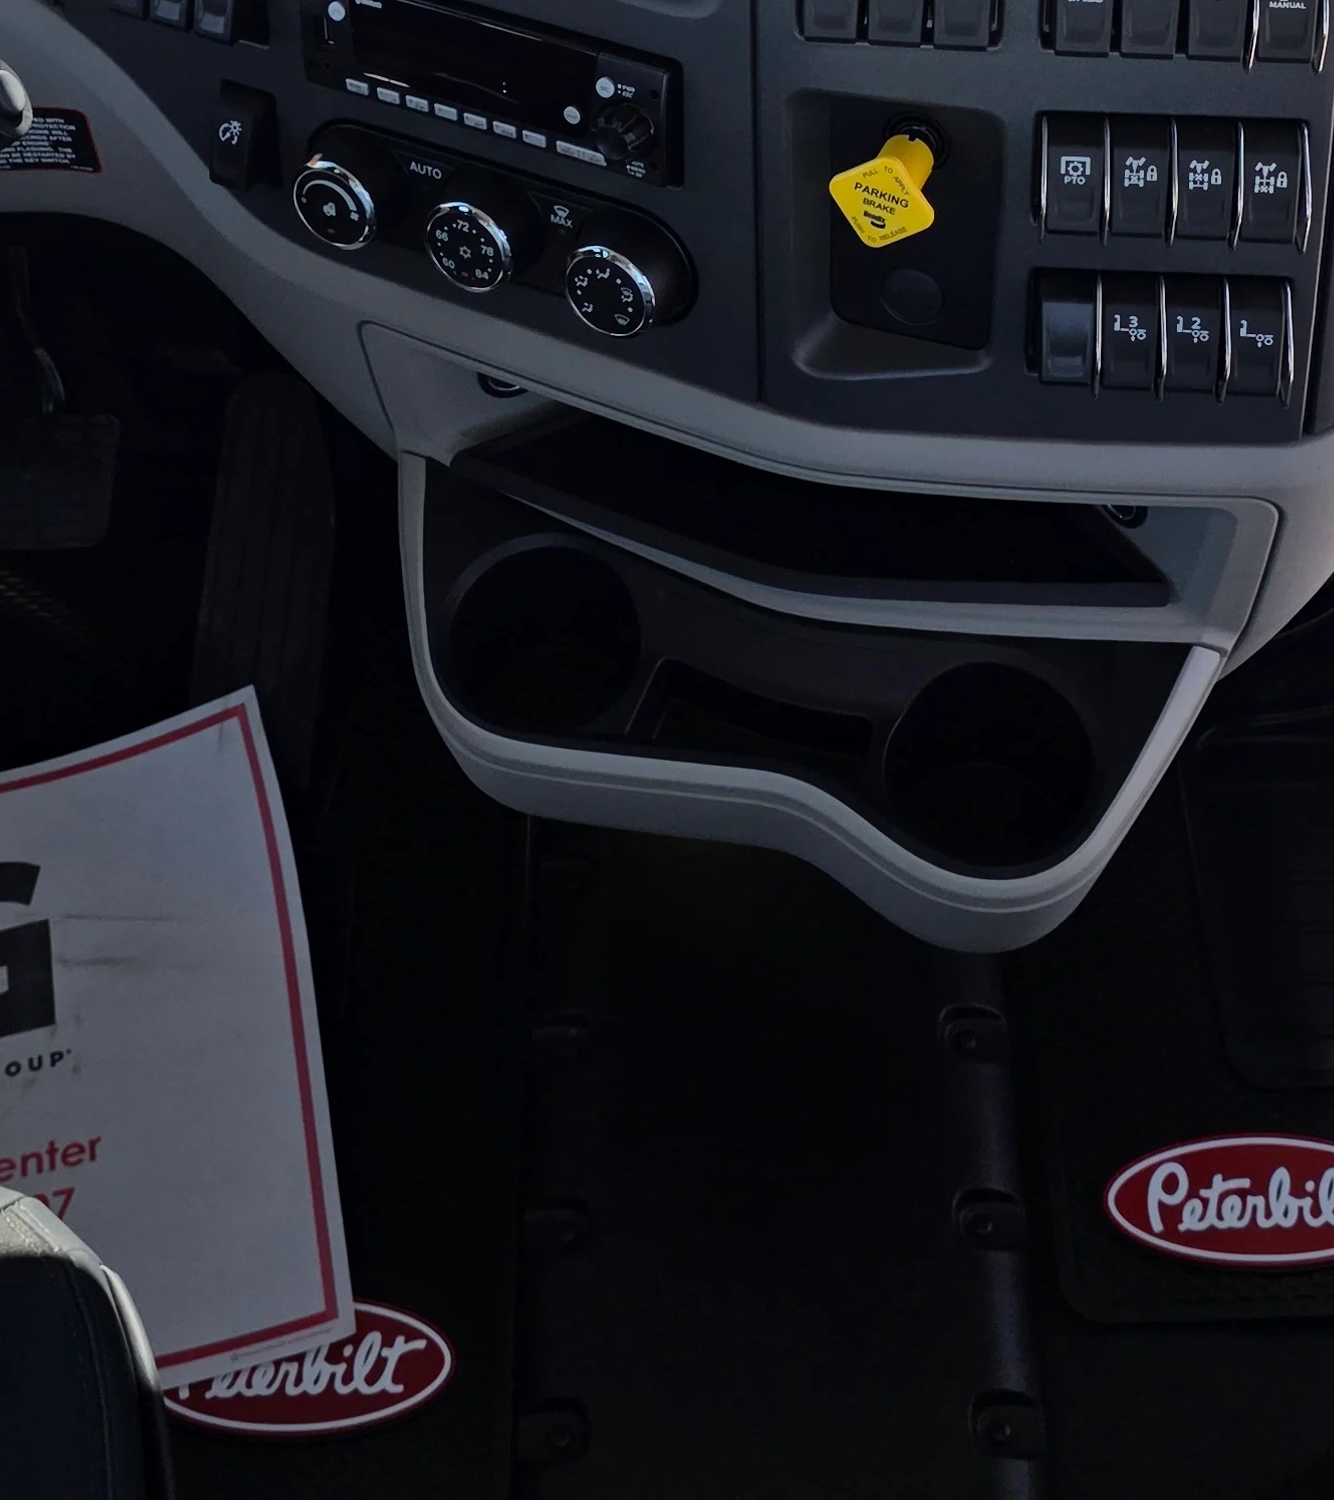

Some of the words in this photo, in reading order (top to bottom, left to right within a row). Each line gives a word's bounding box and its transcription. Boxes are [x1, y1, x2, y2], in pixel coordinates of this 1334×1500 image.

[1269, 1, 1307, 10] MANUAL
[409, 162, 442, 180] AUTO
[862, 168, 879, 179] PULL
[883, 165, 894, 174] TO
[1064, 176, 1086, 185] PTO
[854, 182, 909, 208] PARKING
[862, 197, 896, 215] BRAKE
[456, 220, 469, 233] 72
[550, 214, 573, 229] MAX
[435, 229, 448, 242] 66
[867, 235, 877, 243] TO
[879, 226, 908, 242] RELEASE
[480, 245, 494, 257] 78
[442, 257, 455, 270] 60
[475, 268, 489, 281] 84
[1129, 316, 1138, 328] 3
[1191, 317, 1201, 329] 2
[178, 1331, 427, 1400] eterbilt
